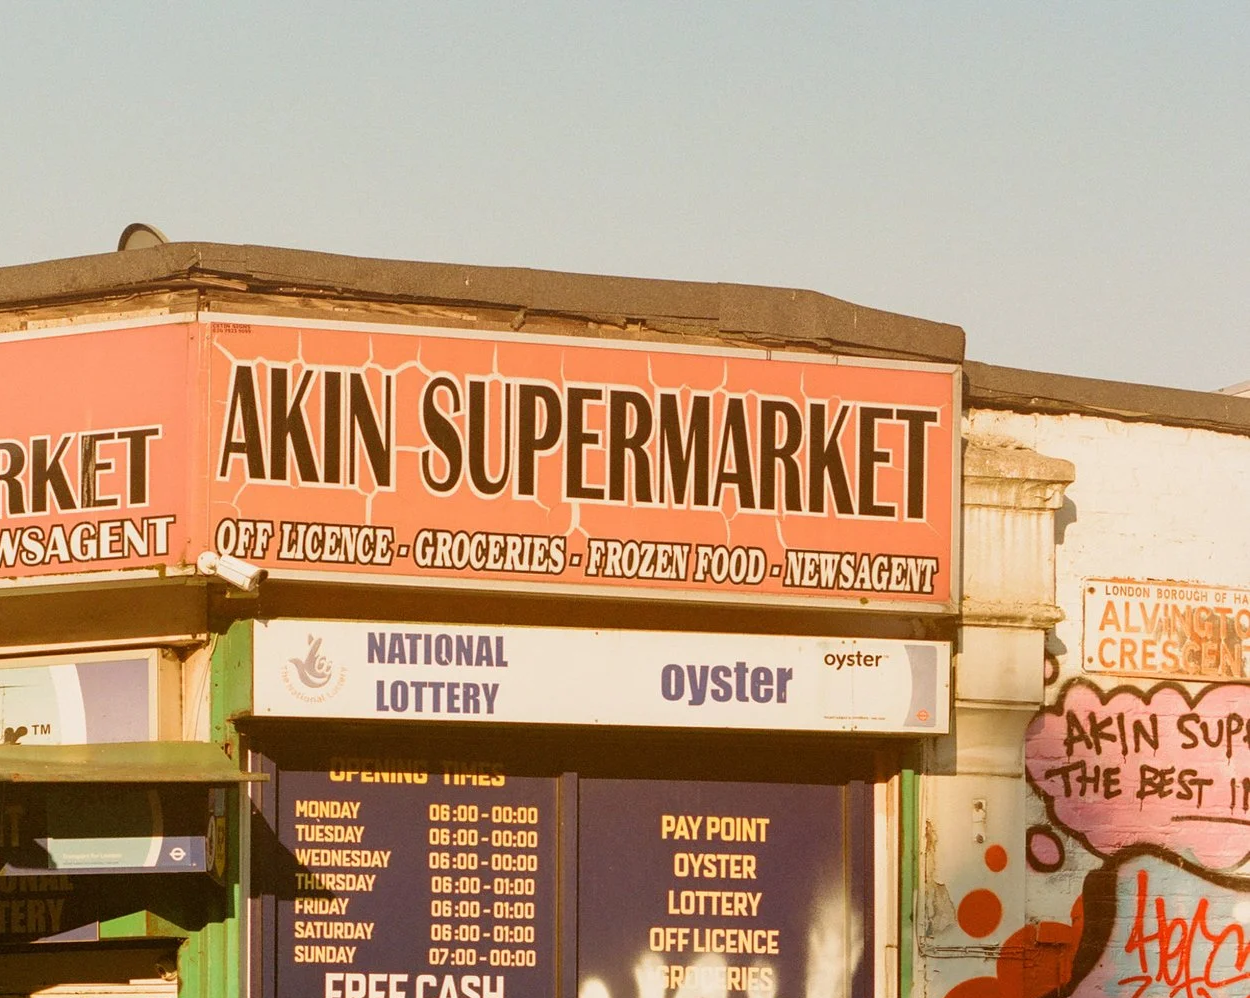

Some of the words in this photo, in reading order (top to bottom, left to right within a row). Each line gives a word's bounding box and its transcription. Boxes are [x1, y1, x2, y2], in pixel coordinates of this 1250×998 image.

[217, 361, 396, 491] AKIN
[417, 372, 941, 522] SUPERMARKET
[214, 519, 274, 558] OFF
[279, 523, 394, 566] LICENCE
[413, 529, 566, 575] GROCERIES
[586, 536, 691, 581] FROZEN
[694, 542, 764, 587] FOOD
[783, 550, 939, 594] NEWSAGENT
[1105, 585, 1150, 598] LONDON
[1157, 588, 1208, 601] BOROUGH
[1214, 592, 1227, 603] OF
[367, 632, 508, 667] NATIONAL
[824, 651, 882, 670] oyster
[1098, 637, 1250, 677] CRESCEN
[376, 680, 499, 714] LOTTERY
[661, 662, 793, 706] oyster
[1063, 709, 1159, 760] AKIN
[1176, 713, 1250, 760] SUP
[330, 757, 428, 783] OPENING
[444, 760, 505, 786] TIMES
[1044, 760, 1122, 799] THE
[1136, 764, 1213, 809] BEST
[295, 800, 361, 819] MONDAY
[295, 824, 365, 843] TUESDAY
[661, 815, 702, 840] PAY
[706, 816, 769, 843] POINT
[295, 848, 391, 868] WEDNESDAY
[673, 853, 756, 879] OYSTER
[295, 873, 376, 892] THURSDAY
[295, 897, 349, 915] FRIDAY
[668, 890, 762, 916] LOTTERY
[294, 921, 374, 940] SATURDAY
[649, 927, 689, 953] OFF
[693, 929, 779, 955] LICENCE
[294, 945, 356, 963] SUNDAY
